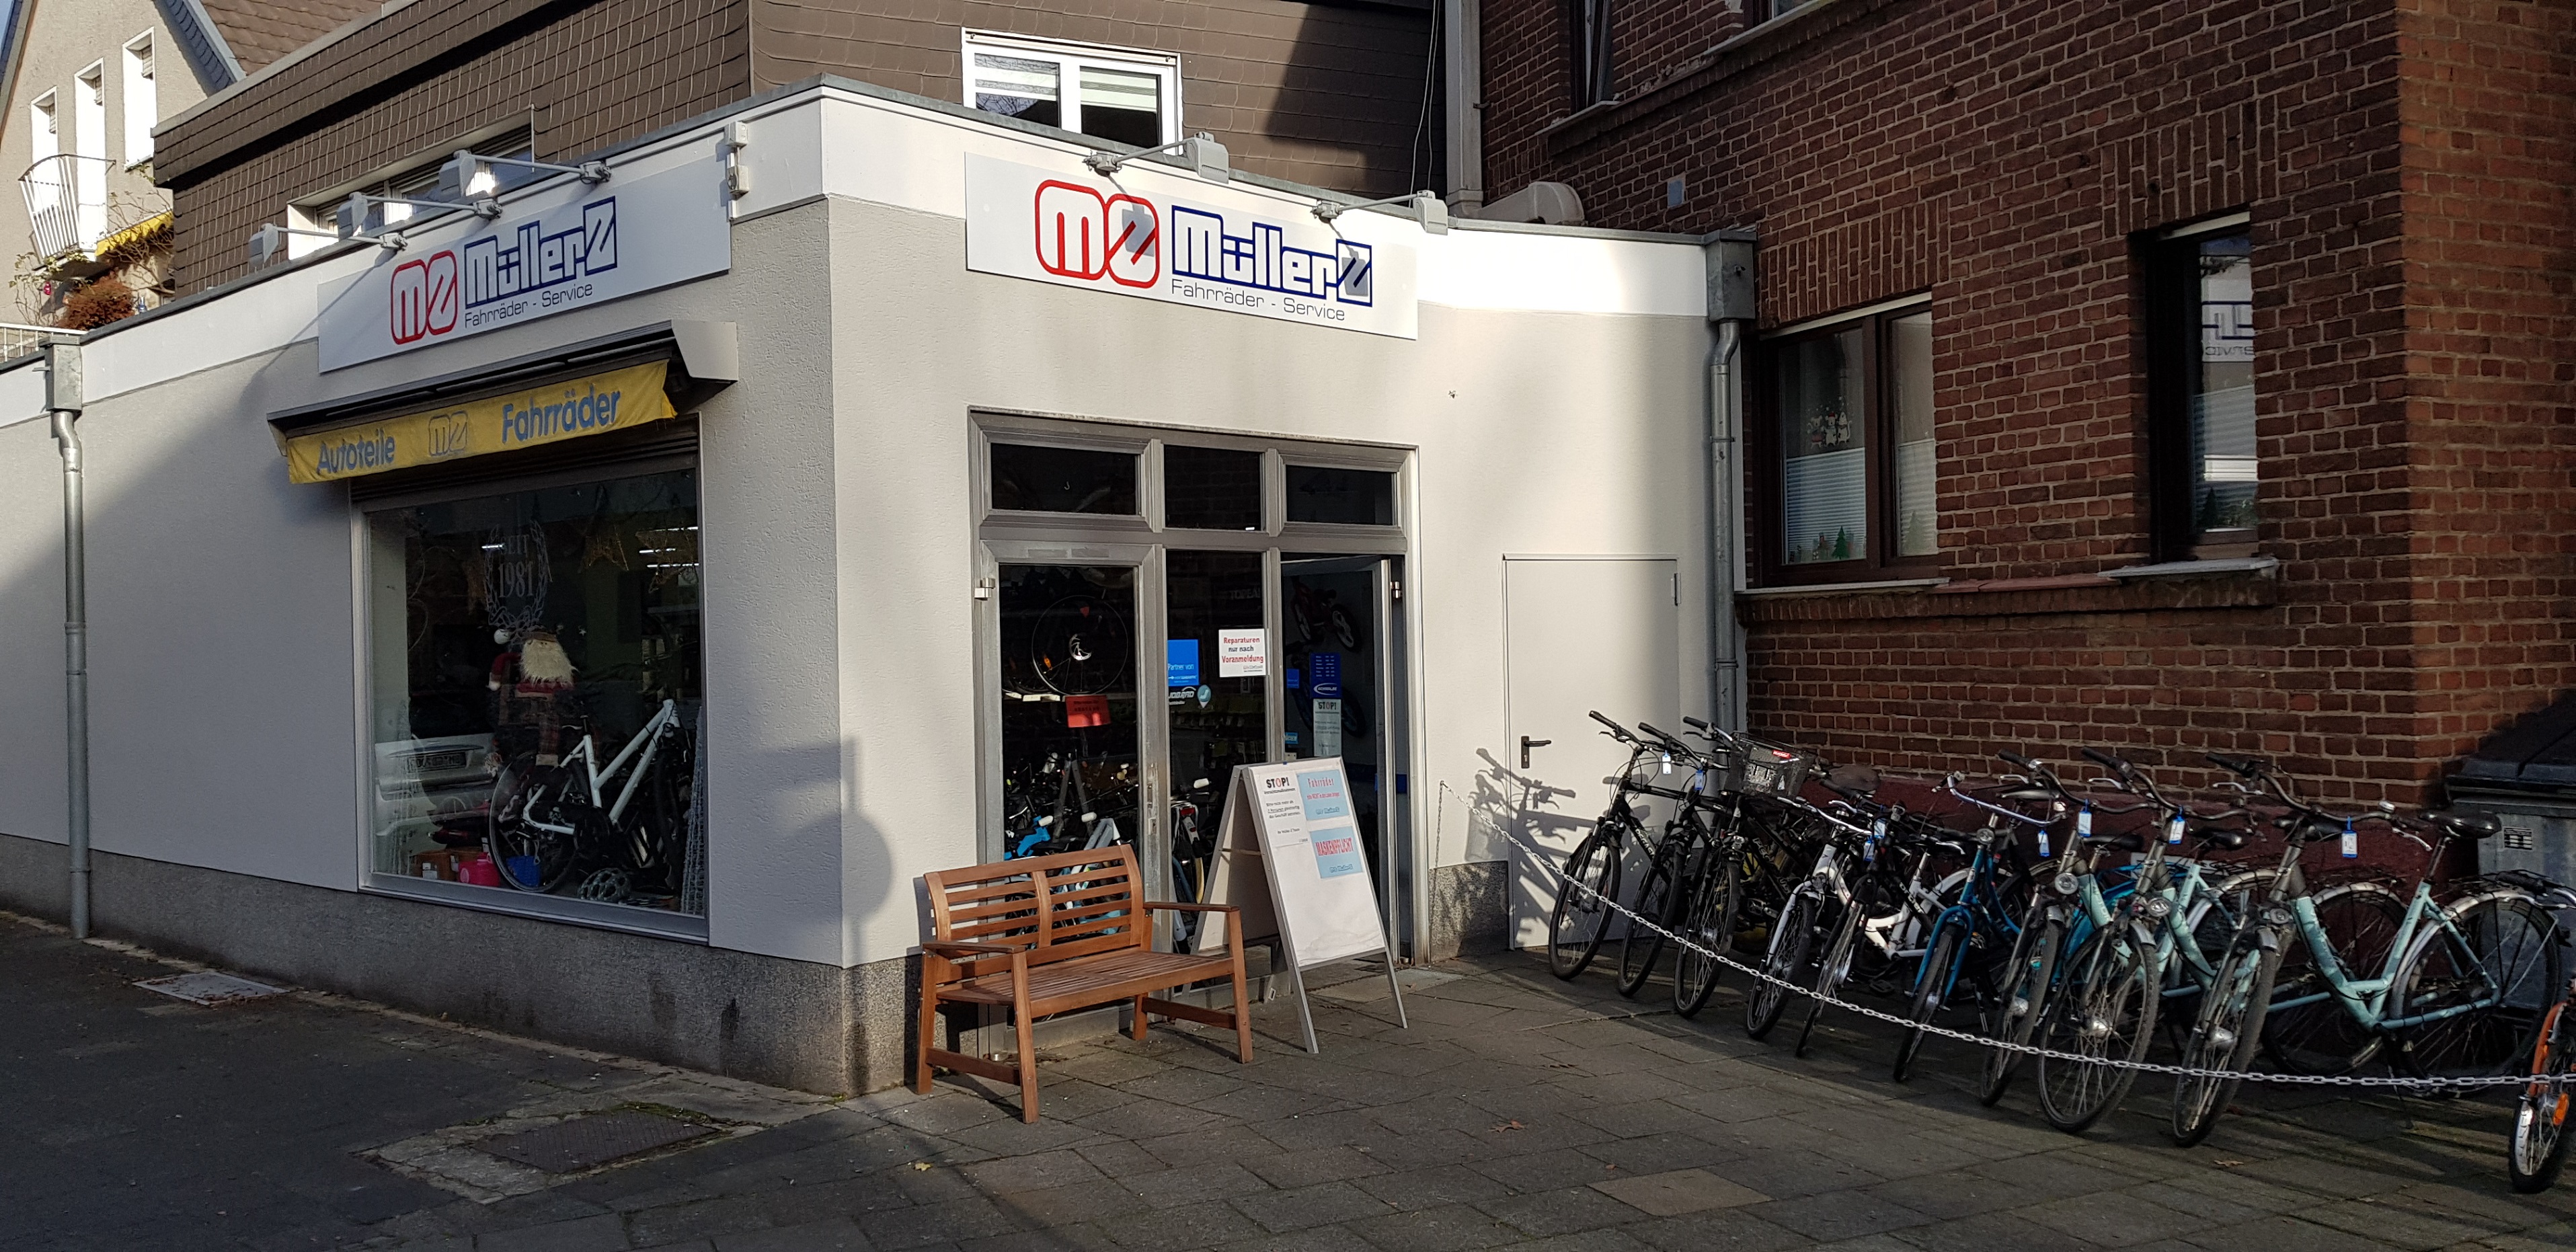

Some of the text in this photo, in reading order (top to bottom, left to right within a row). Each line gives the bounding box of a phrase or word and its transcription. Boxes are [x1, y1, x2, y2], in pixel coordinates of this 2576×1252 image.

[465, 298, 529, 329] Fahrräder
[541, 282, 593, 308] Service
[1171, 278, 1265, 309] Fahrräder
[1283, 297, 1345, 321] Service
[316, 428, 395, 475] Autoteile
[501, 385, 621, 443] Fahrräder
[498, 561, 534, 598] 1981
[1223, 637, 1260, 645] Reparaturen
[1222, 655, 1264, 664] Voranmeldung
[1266, 777, 1290, 788] STOP!
[1635, 828, 1655, 858] PEGAS
